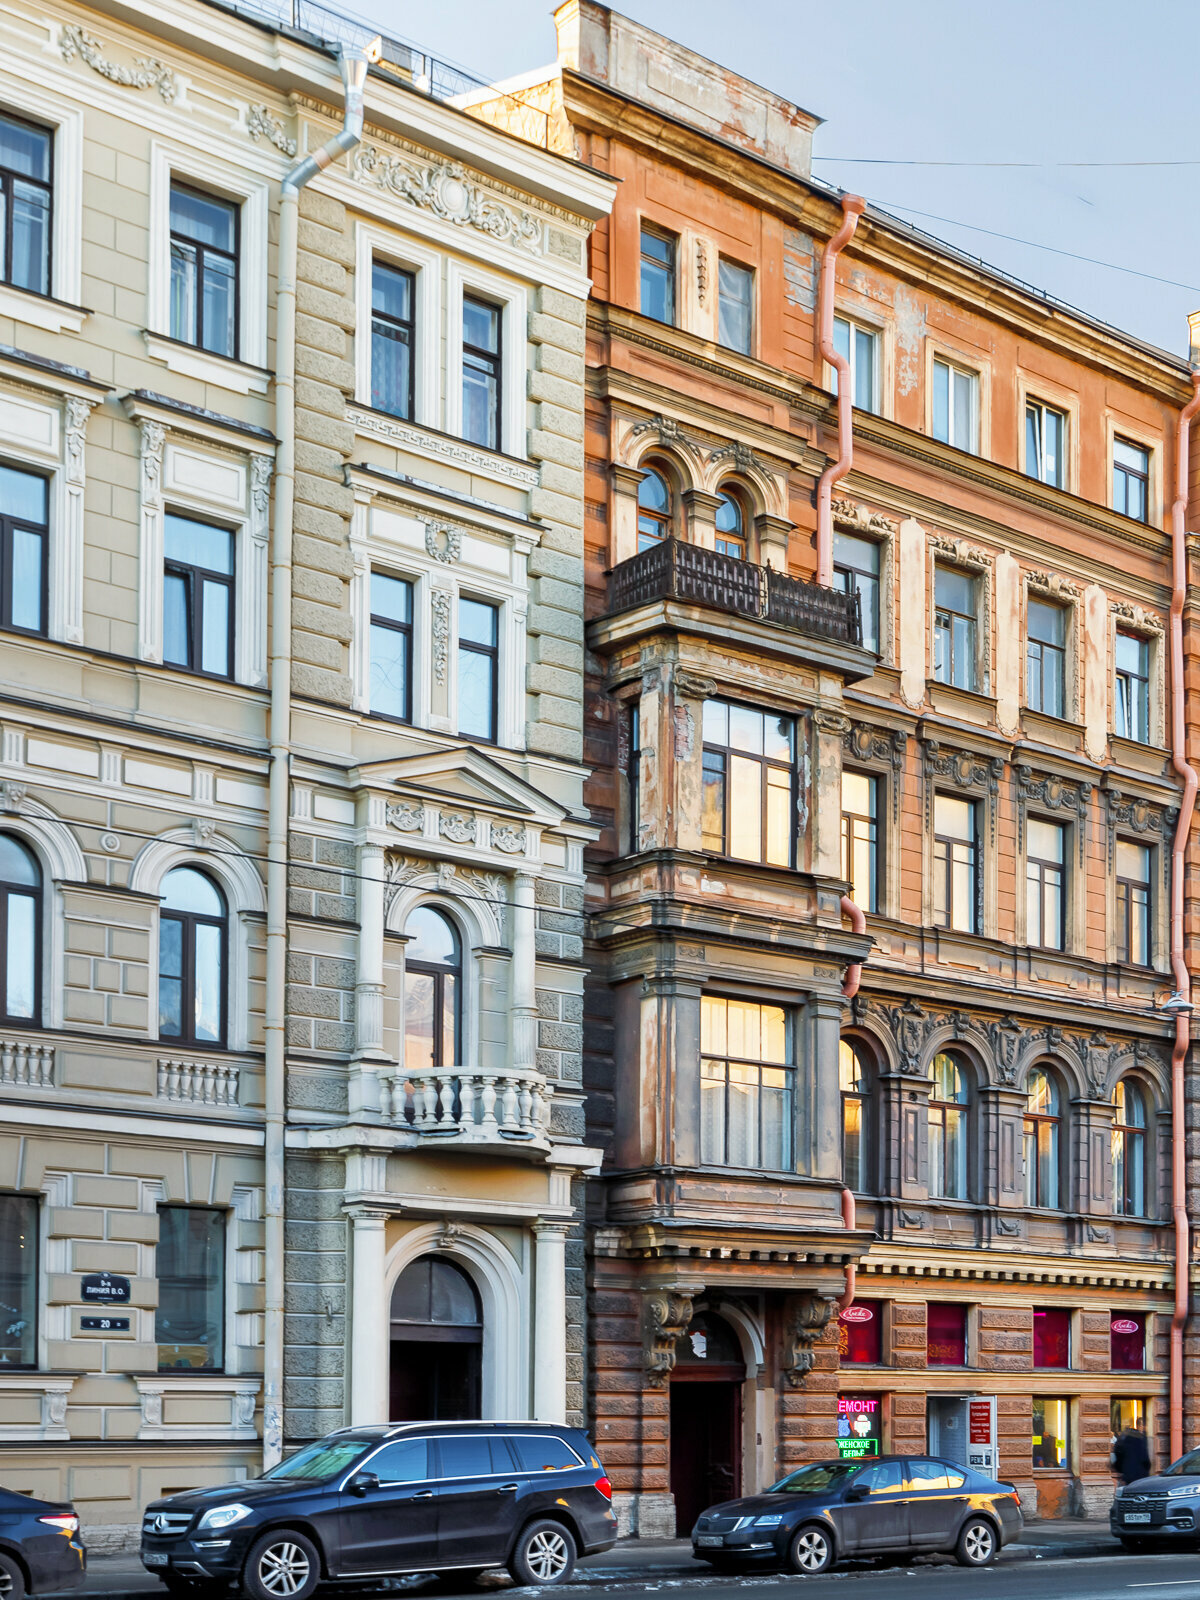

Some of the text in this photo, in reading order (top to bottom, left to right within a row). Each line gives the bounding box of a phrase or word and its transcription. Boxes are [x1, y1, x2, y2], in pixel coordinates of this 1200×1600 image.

[86, 1286, 110, 1294] ЛИНИЯ
[100, 1319, 111, 1328] 20
[838, 1400, 878, 1413] ЕМОНТ
[838, 1440, 871, 1449] ЖЕНСКОЕ
